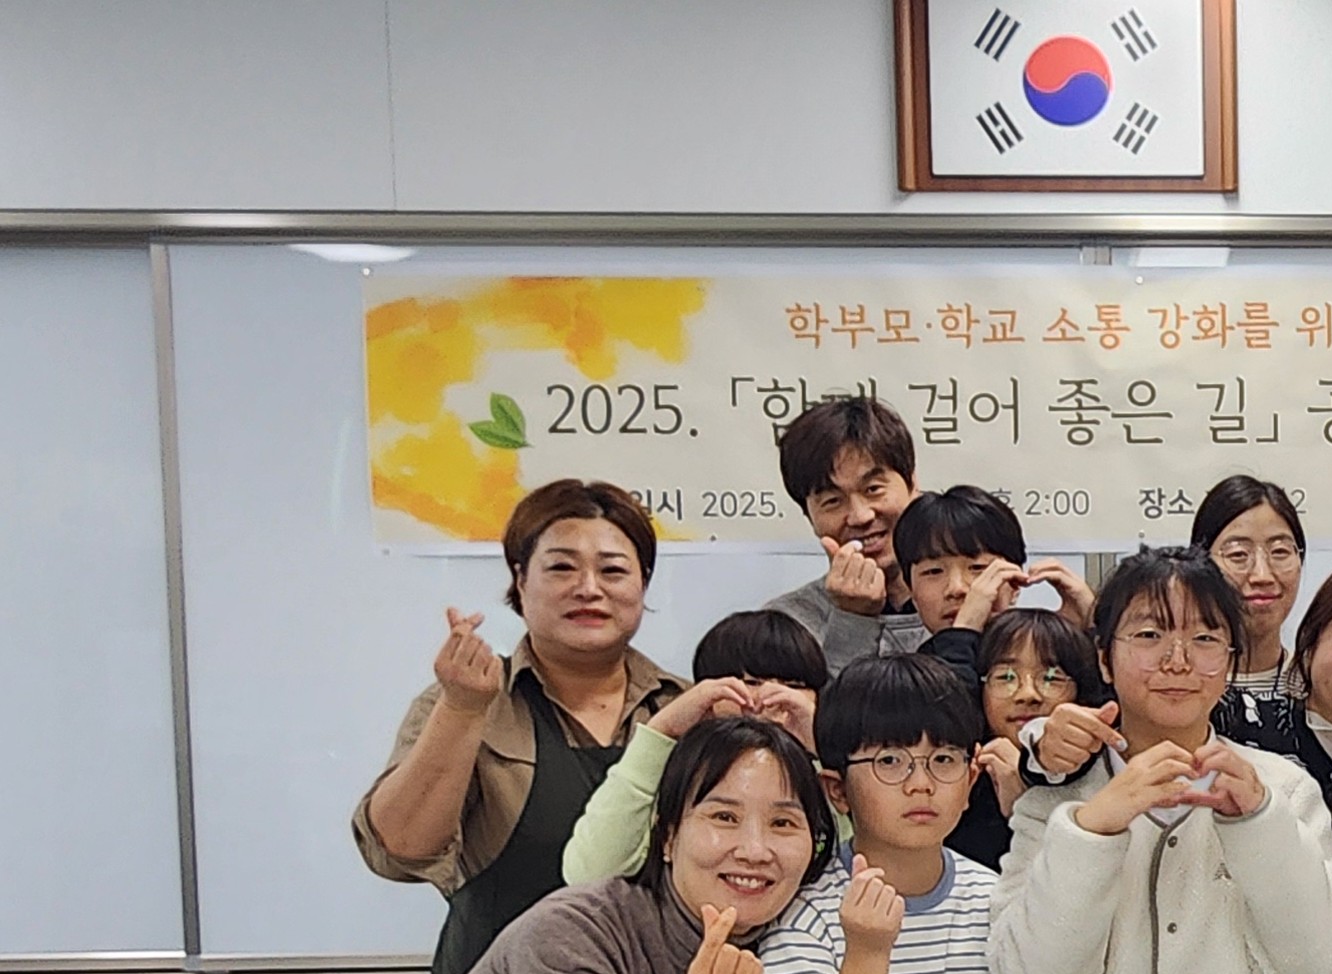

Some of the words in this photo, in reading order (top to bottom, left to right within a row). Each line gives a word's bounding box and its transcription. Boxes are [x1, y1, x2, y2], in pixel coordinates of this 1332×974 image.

[785, 302, 1025, 349] 학부모·학교
[1042, 303, 1130, 349] 소통
[1148, 302, 1280, 349] 강화를
[546, 383, 699, 437] 2025.
[908, 376, 1019, 446] 걸어
[1049, 378, 1173, 446] 좋은
[1196, 377, 1280, 446] 길」
[702, 490, 783, 518] 2025.
[1025, 490, 1090, 515] 2:00
[1138, 487, 1195, 519] 장소
